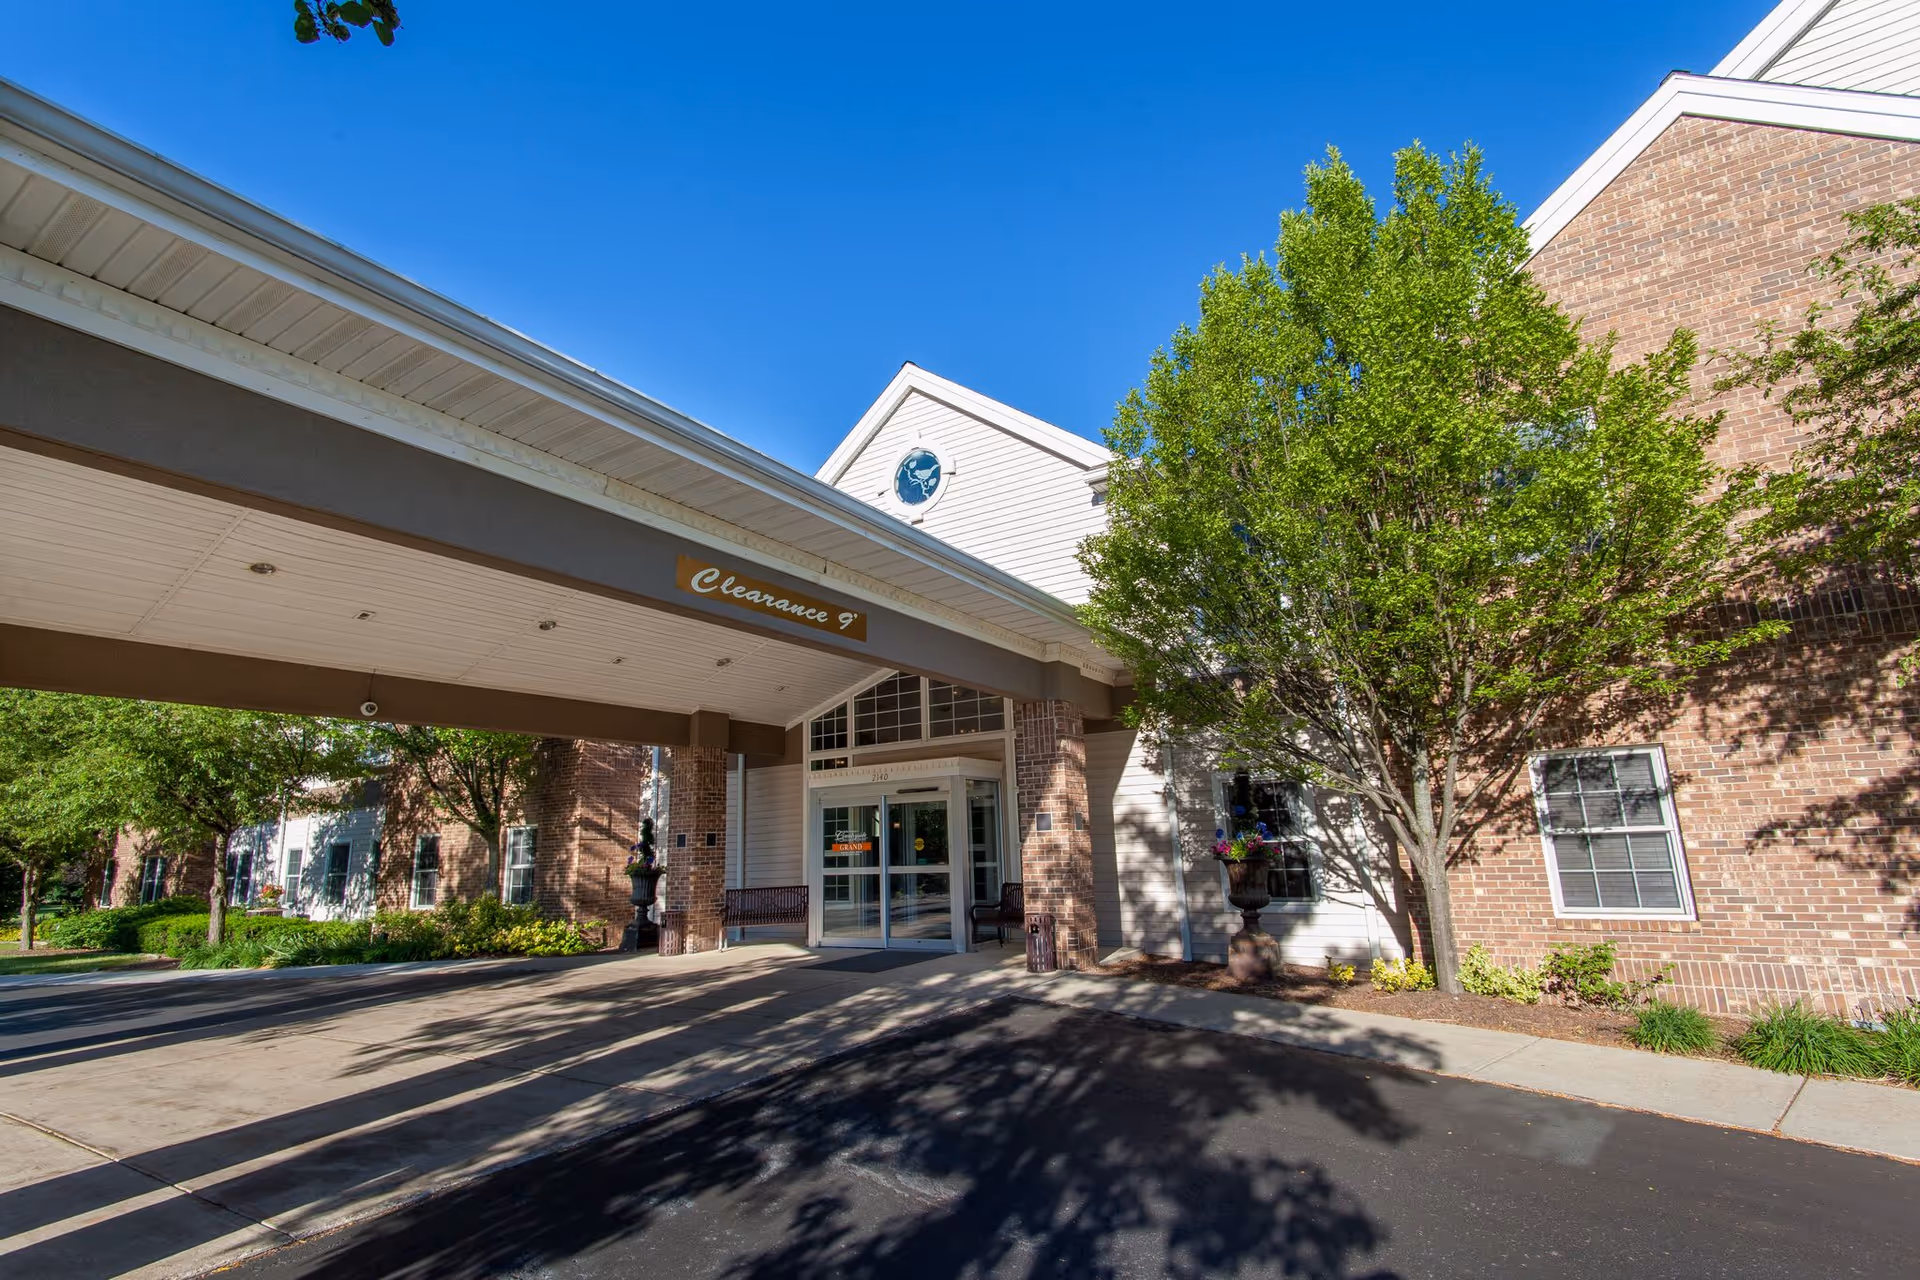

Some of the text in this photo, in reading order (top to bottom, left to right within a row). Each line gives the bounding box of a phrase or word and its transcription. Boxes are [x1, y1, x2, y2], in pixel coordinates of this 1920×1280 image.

[690, 567, 828, 623] Clearance
[872, 773, 889, 782] 2140
[839, 843, 863, 851] GRAND
